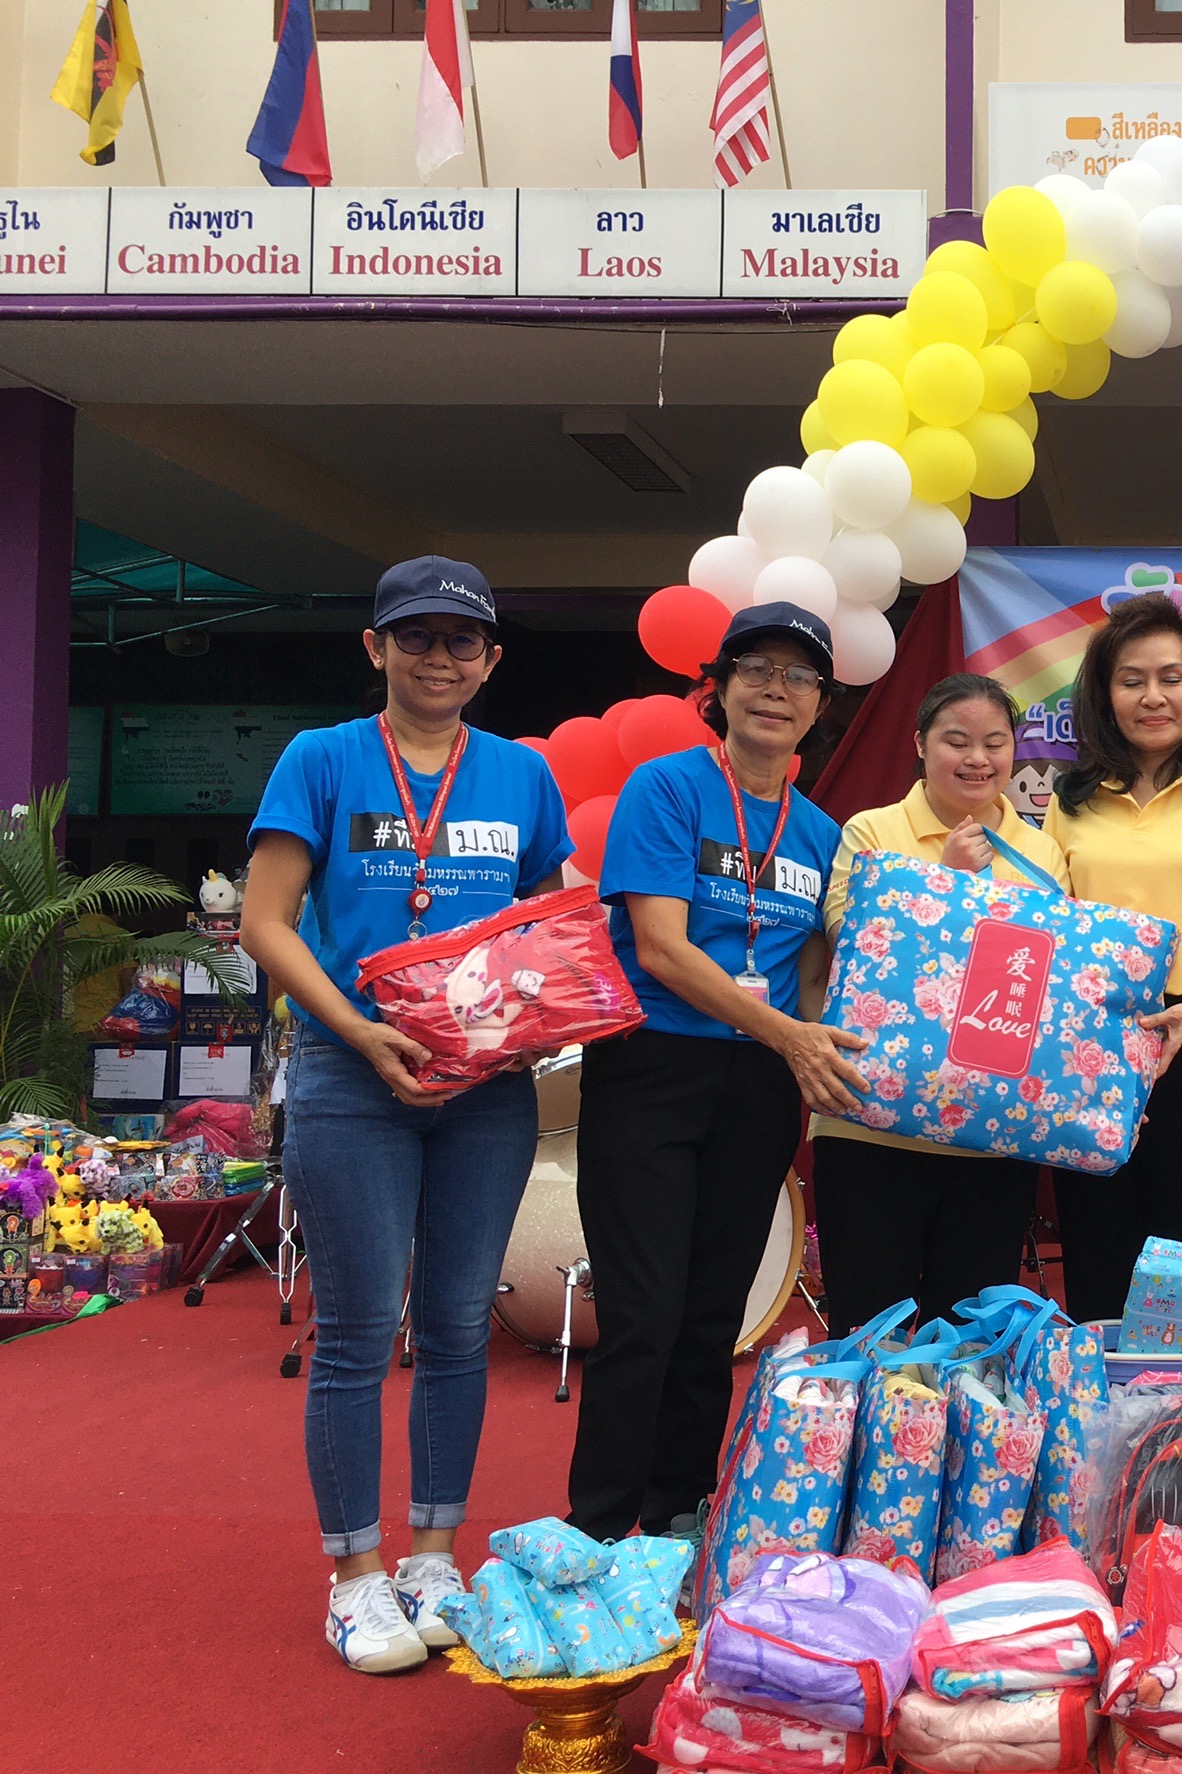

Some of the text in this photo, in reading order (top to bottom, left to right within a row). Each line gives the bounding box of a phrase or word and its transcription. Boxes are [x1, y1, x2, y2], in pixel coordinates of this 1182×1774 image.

[169, 202, 253, 238] กัมพูชา
[346, 198, 484, 231] อินโดนีเซีย
[597, 211, 644, 232] ลาว
[771, 203, 881, 233] มาเลเซีย
[117, 244, 300, 274] Cambodia
[329, 245, 503, 276] Indonesia
[577, 247, 662, 278] Laos
[740, 248, 900, 285] Malaysia
[959, 989, 1032, 1039] Love
